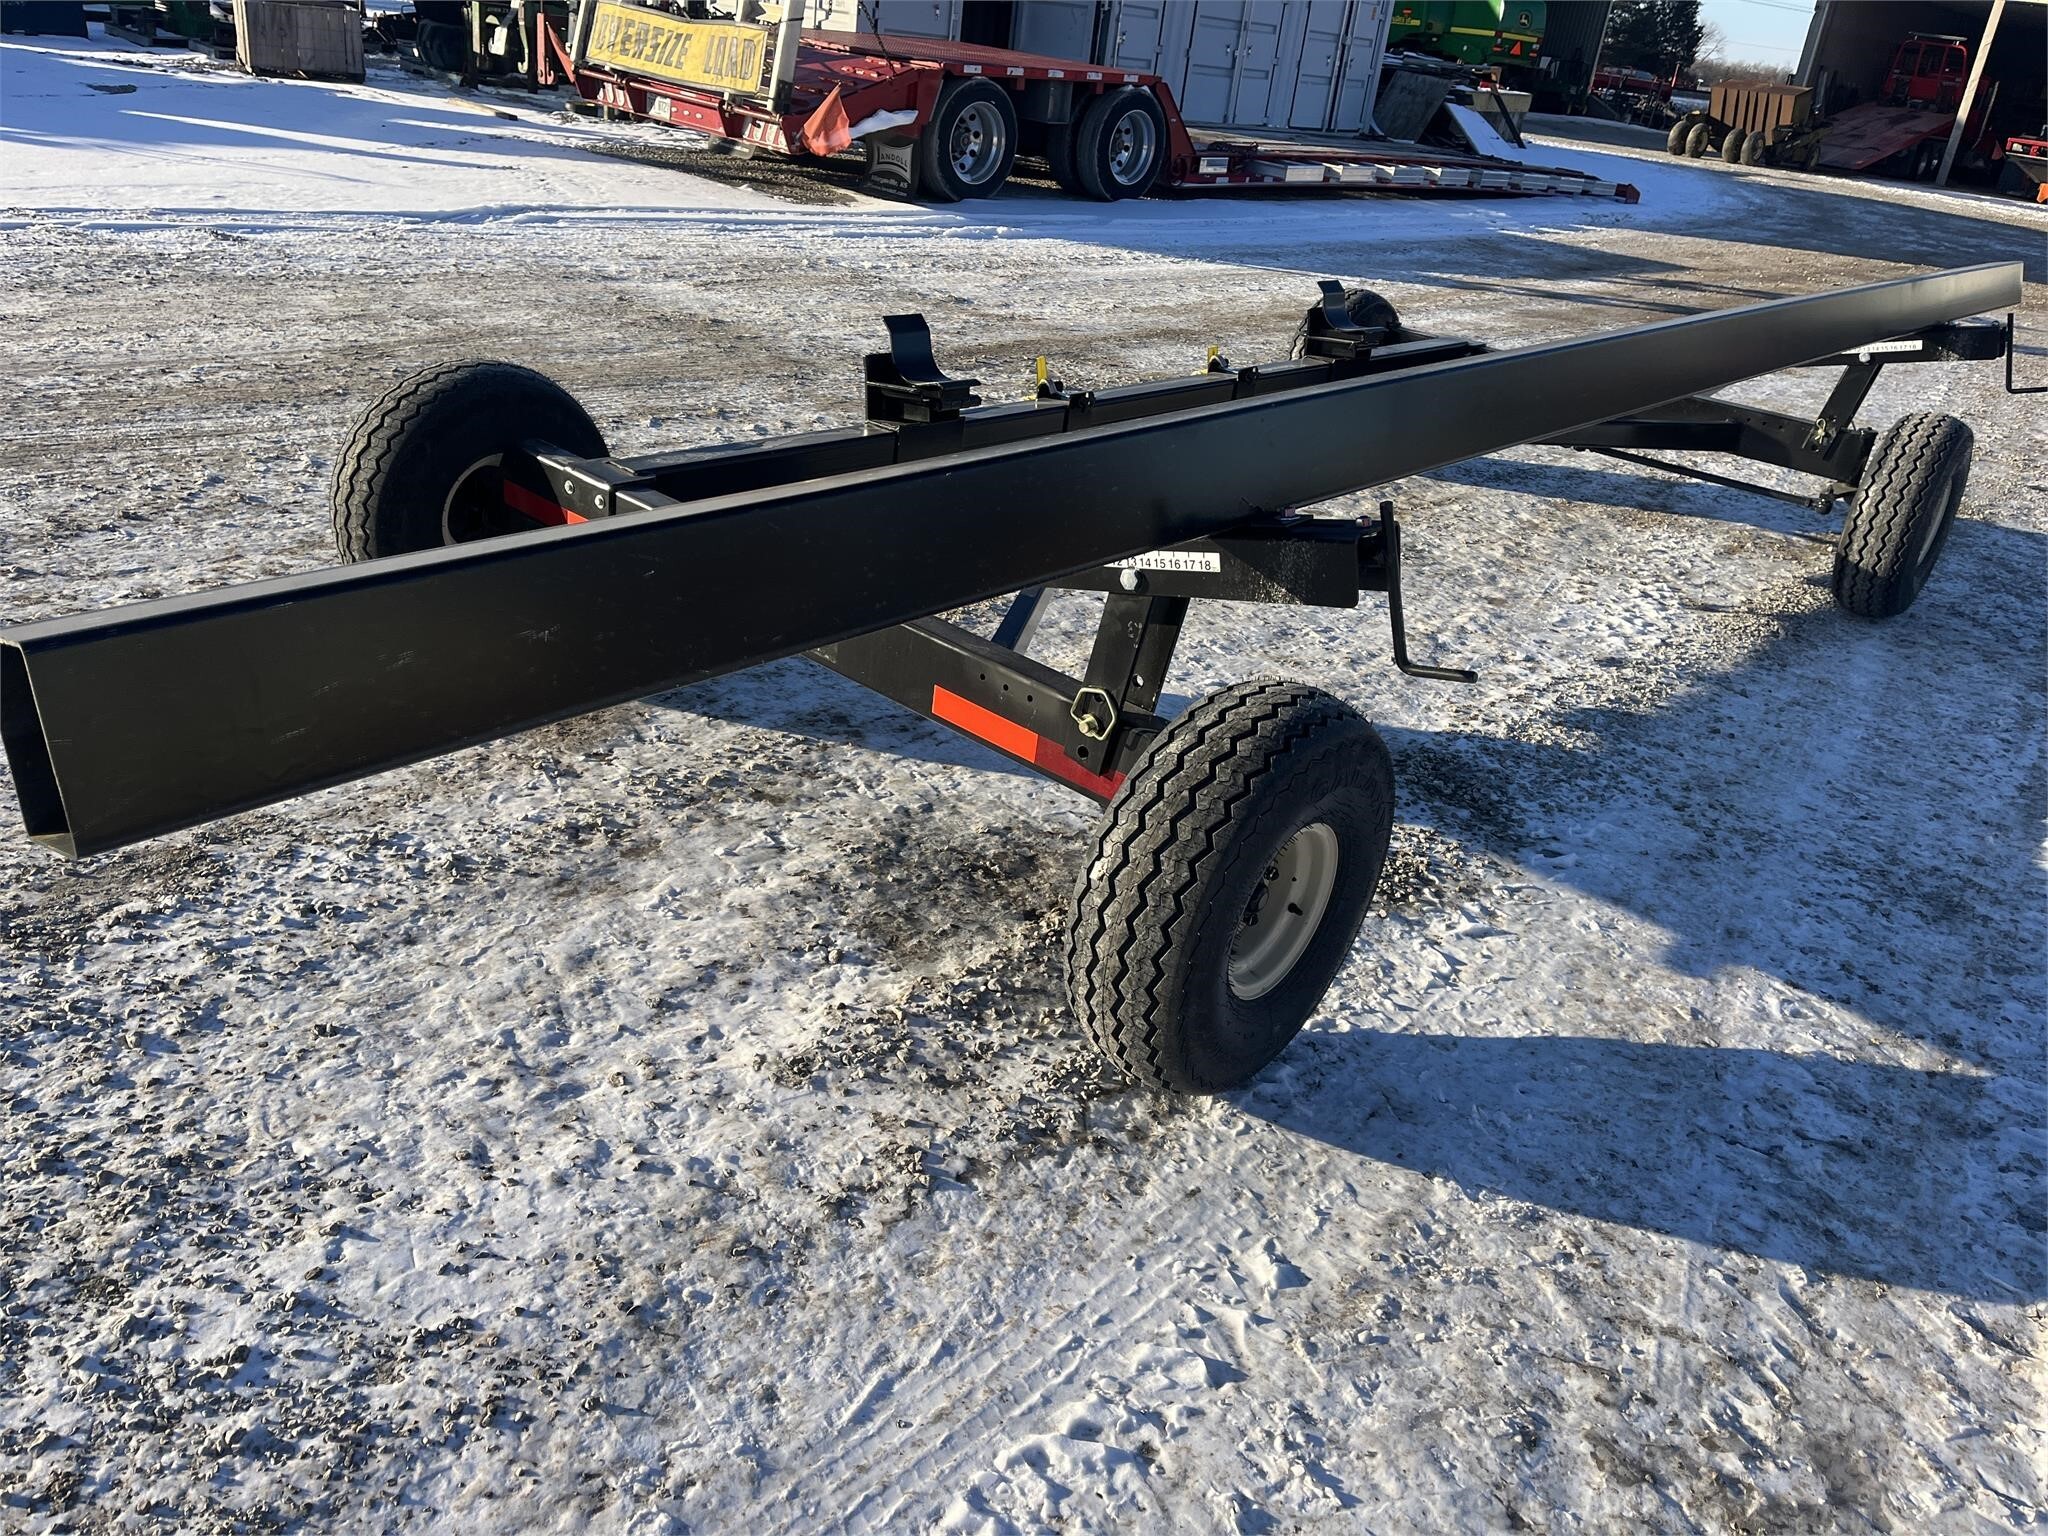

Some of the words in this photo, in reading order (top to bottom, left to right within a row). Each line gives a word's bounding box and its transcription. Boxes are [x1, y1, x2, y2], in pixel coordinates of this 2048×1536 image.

[595, 13, 693, 70] OVERSIZE
[703, 34, 757, 80] LOAD
[1140, 558, 1151, 568] 14
[1153, 558, 1166, 569] 15
[1169, 559, 1181, 569] 16
[1184, 559, 1196, 570] 17
[1198, 560, 1211, 571] 18
